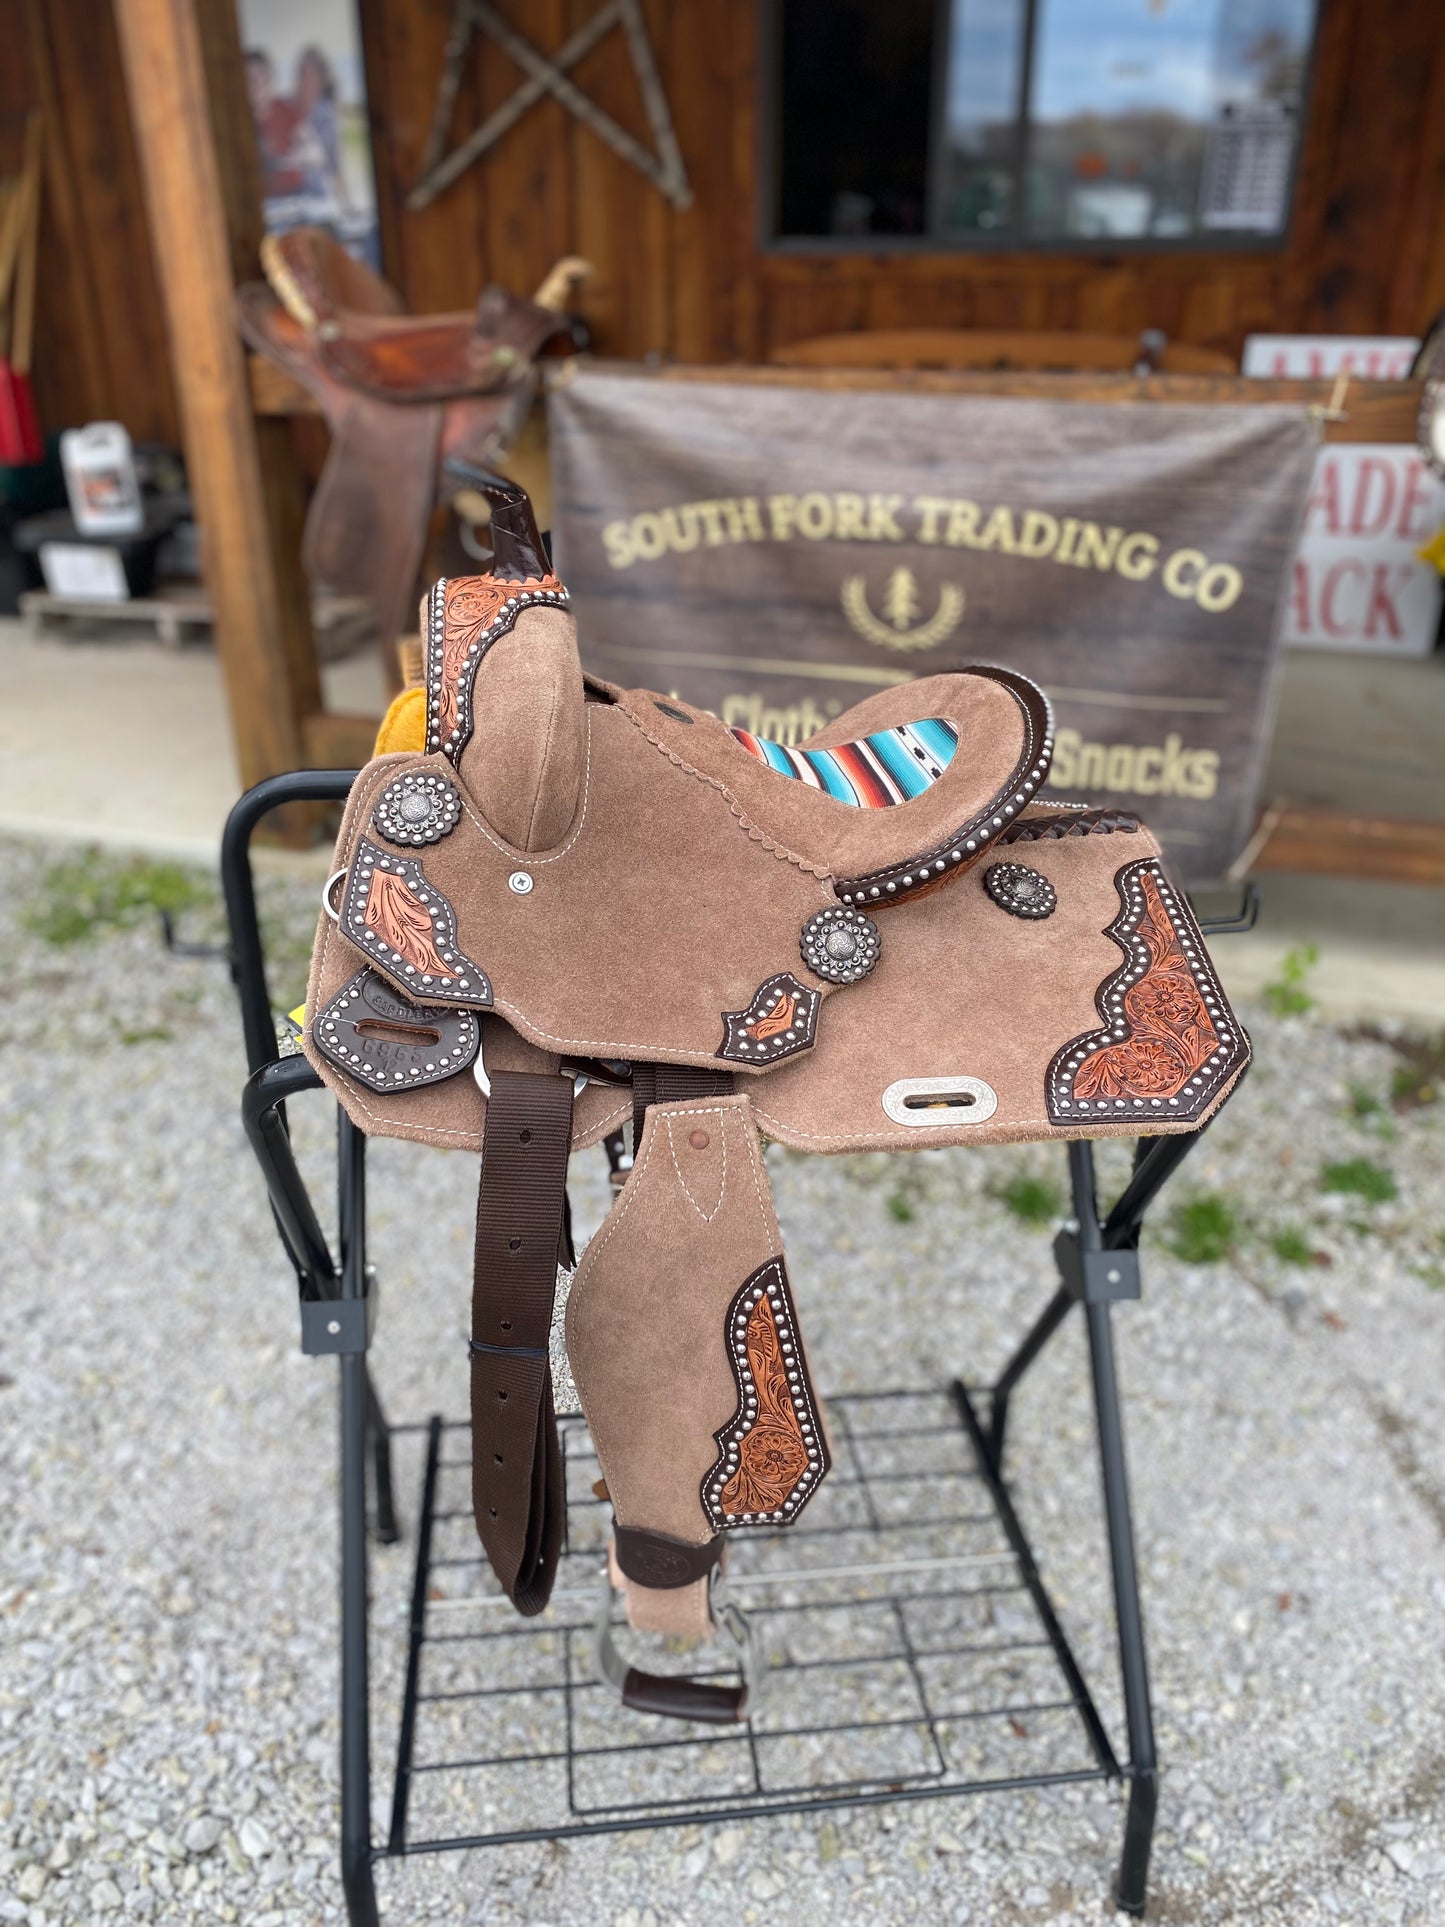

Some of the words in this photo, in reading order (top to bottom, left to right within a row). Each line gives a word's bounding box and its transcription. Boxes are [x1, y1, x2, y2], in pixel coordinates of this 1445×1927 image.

[1304, 456, 1432, 540] ADE
[603, 496, 765, 569] SOUTH
[769, 492, 906, 542] FORK
[912, 496, 1160, 582] TRADING
[1161, 547, 1243, 613] CO
[1049, 728, 1222, 800] Snacks
